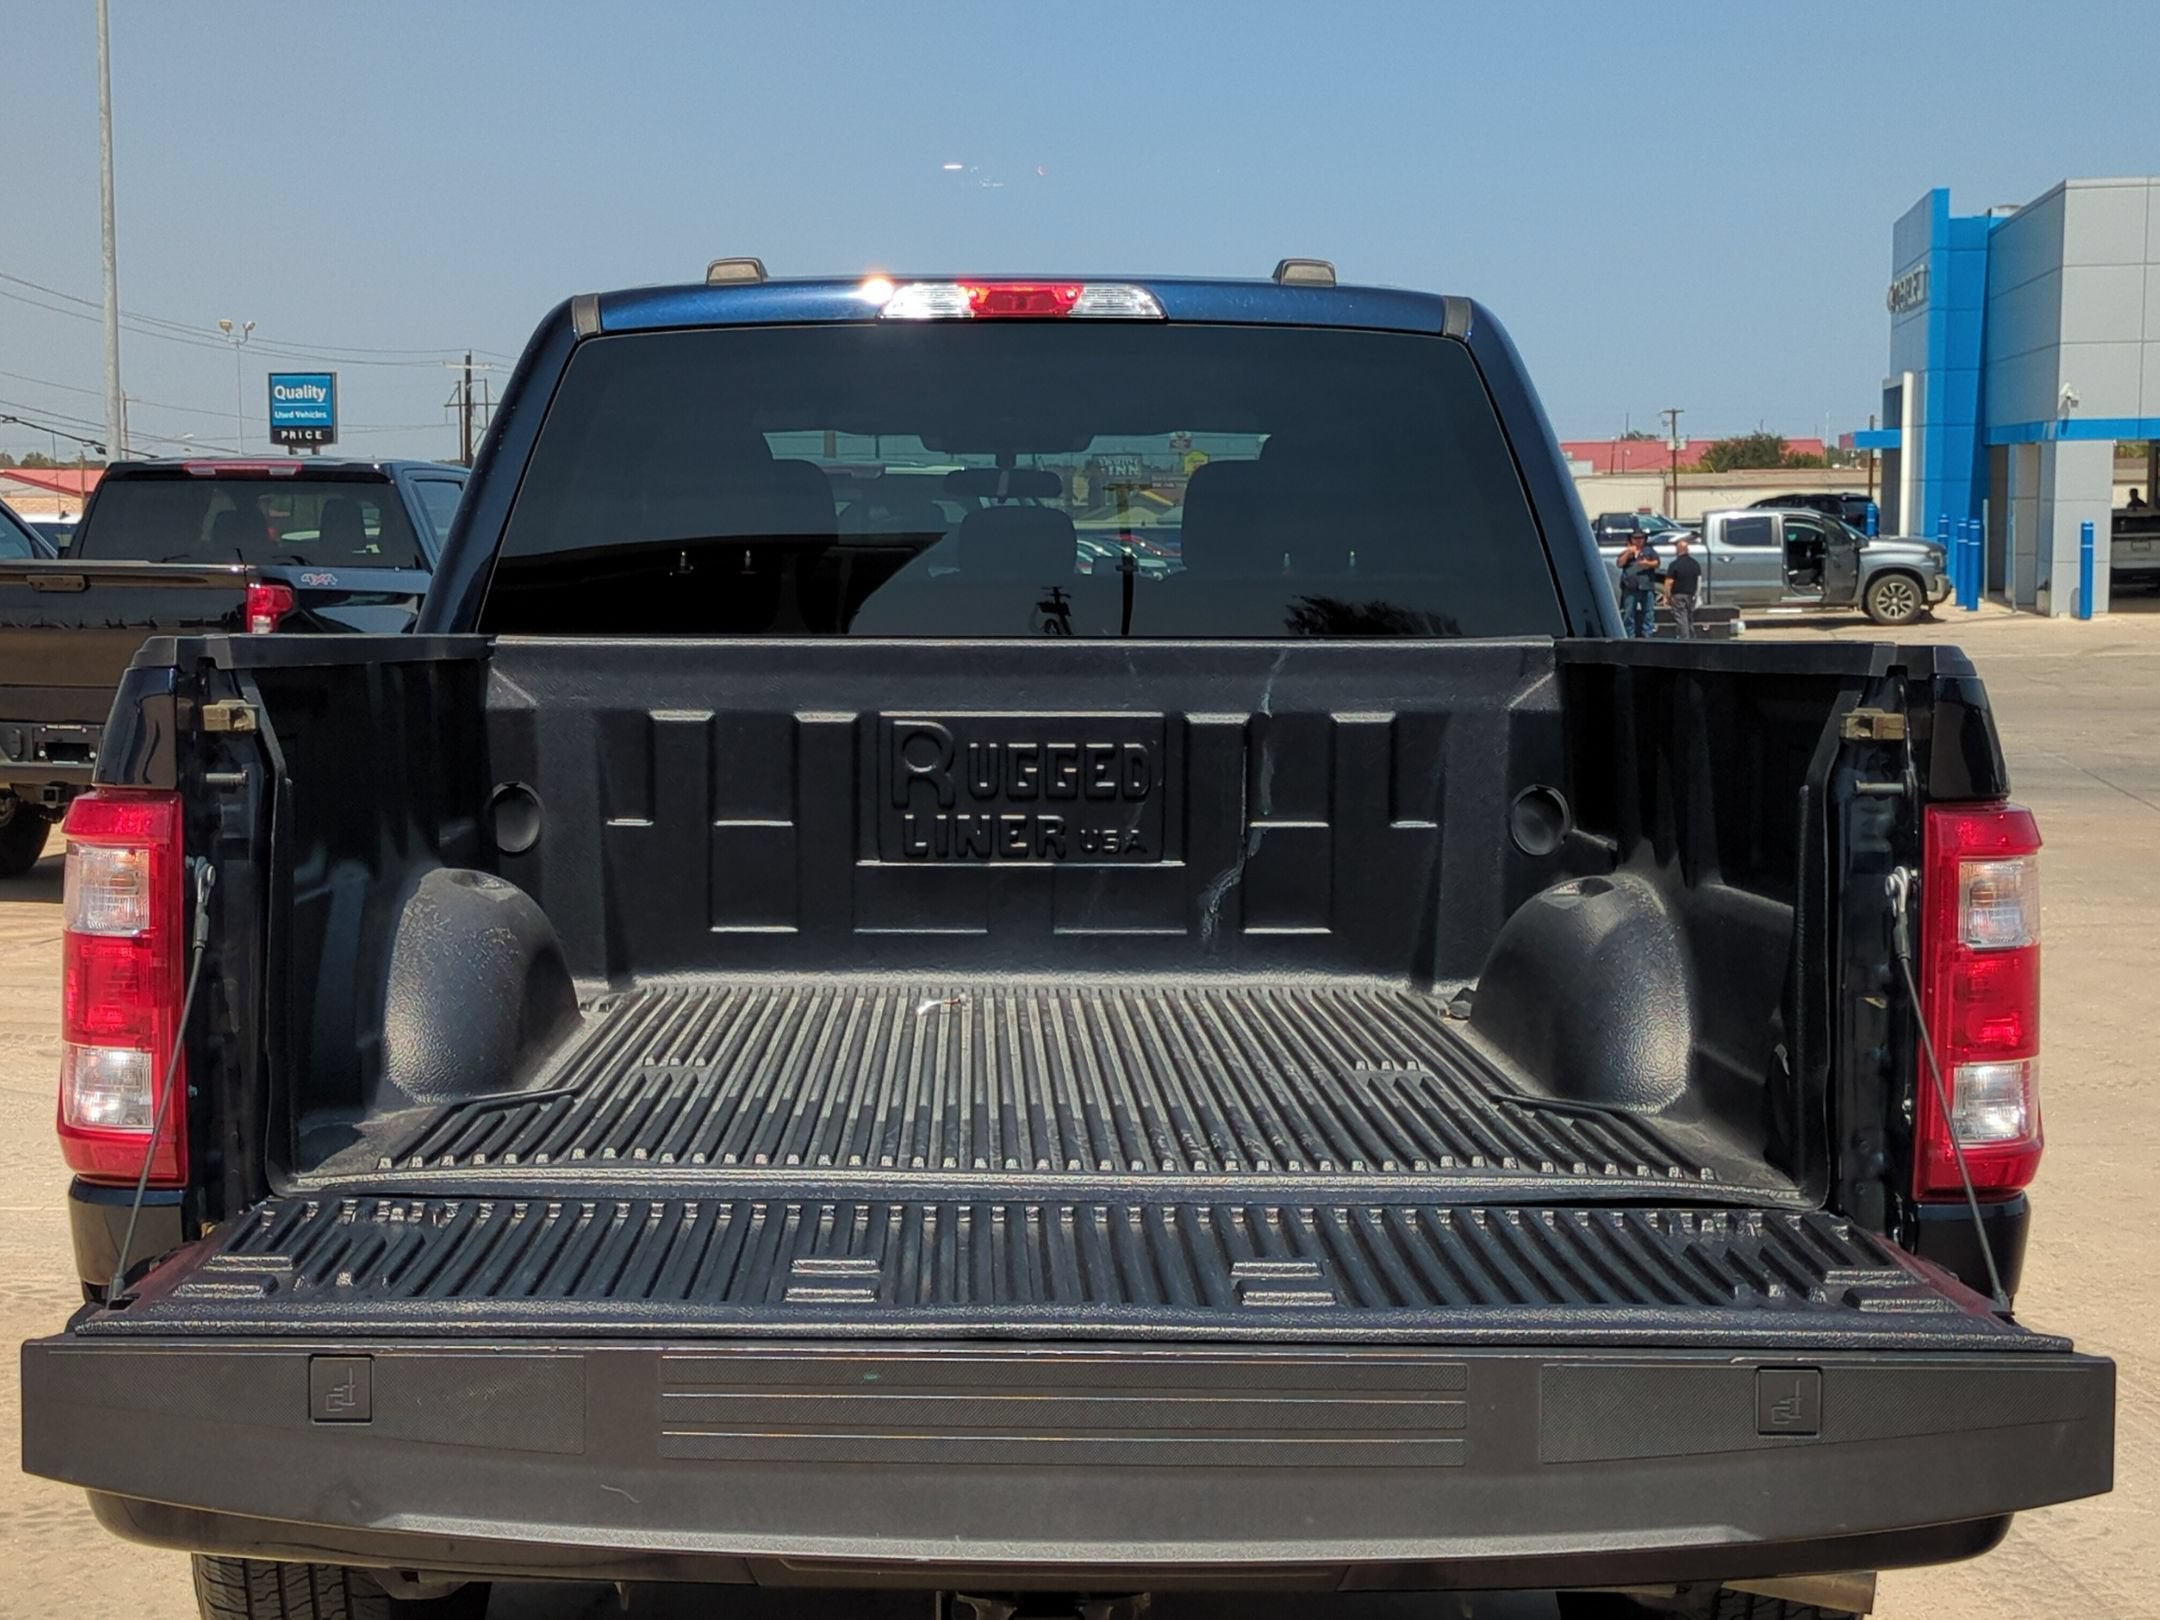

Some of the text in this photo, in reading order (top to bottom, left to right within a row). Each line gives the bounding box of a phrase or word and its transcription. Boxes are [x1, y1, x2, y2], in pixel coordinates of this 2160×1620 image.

[274, 384, 327, 402] Quality
[274, 410, 327, 419] Used Vehicles
[281, 430, 322, 440] PRICE
[892, 719, 1150, 809] RUGGED
[903, 814, 1147, 859] LINER USA
